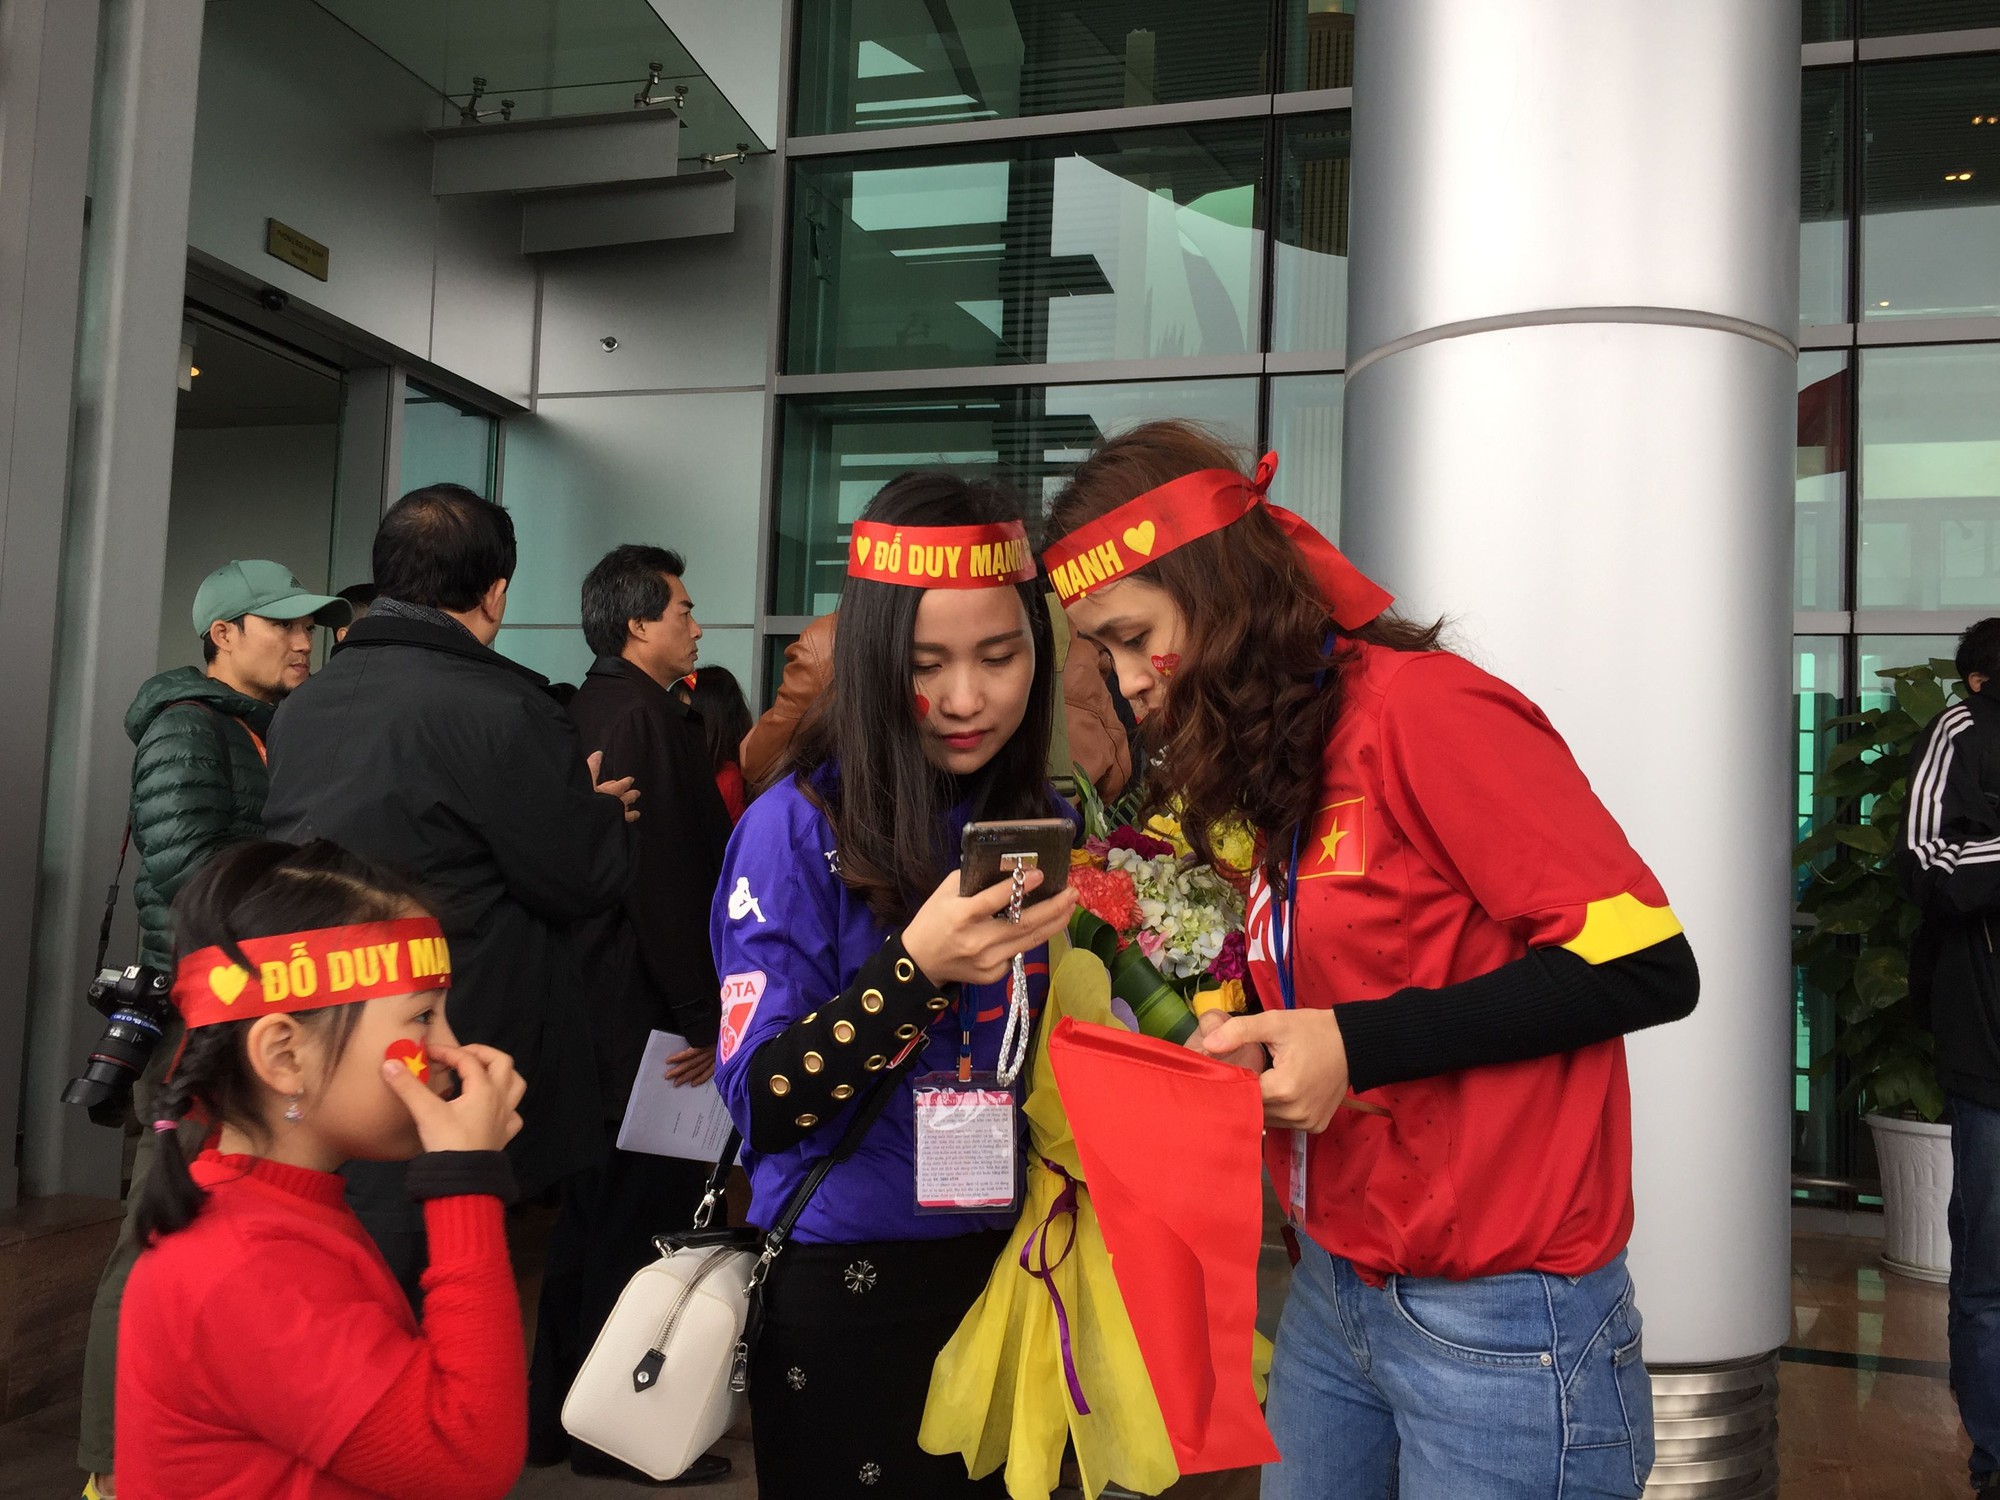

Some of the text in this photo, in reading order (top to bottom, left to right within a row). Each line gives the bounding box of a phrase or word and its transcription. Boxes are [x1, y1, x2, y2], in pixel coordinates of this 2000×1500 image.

[873, 533, 1024, 582] ĐỖ DUY MẠNH
[1051, 540, 1124, 600] MẠNH
[260, 941, 318, 1002] ĐỖ
[326, 942, 399, 992] DUY
